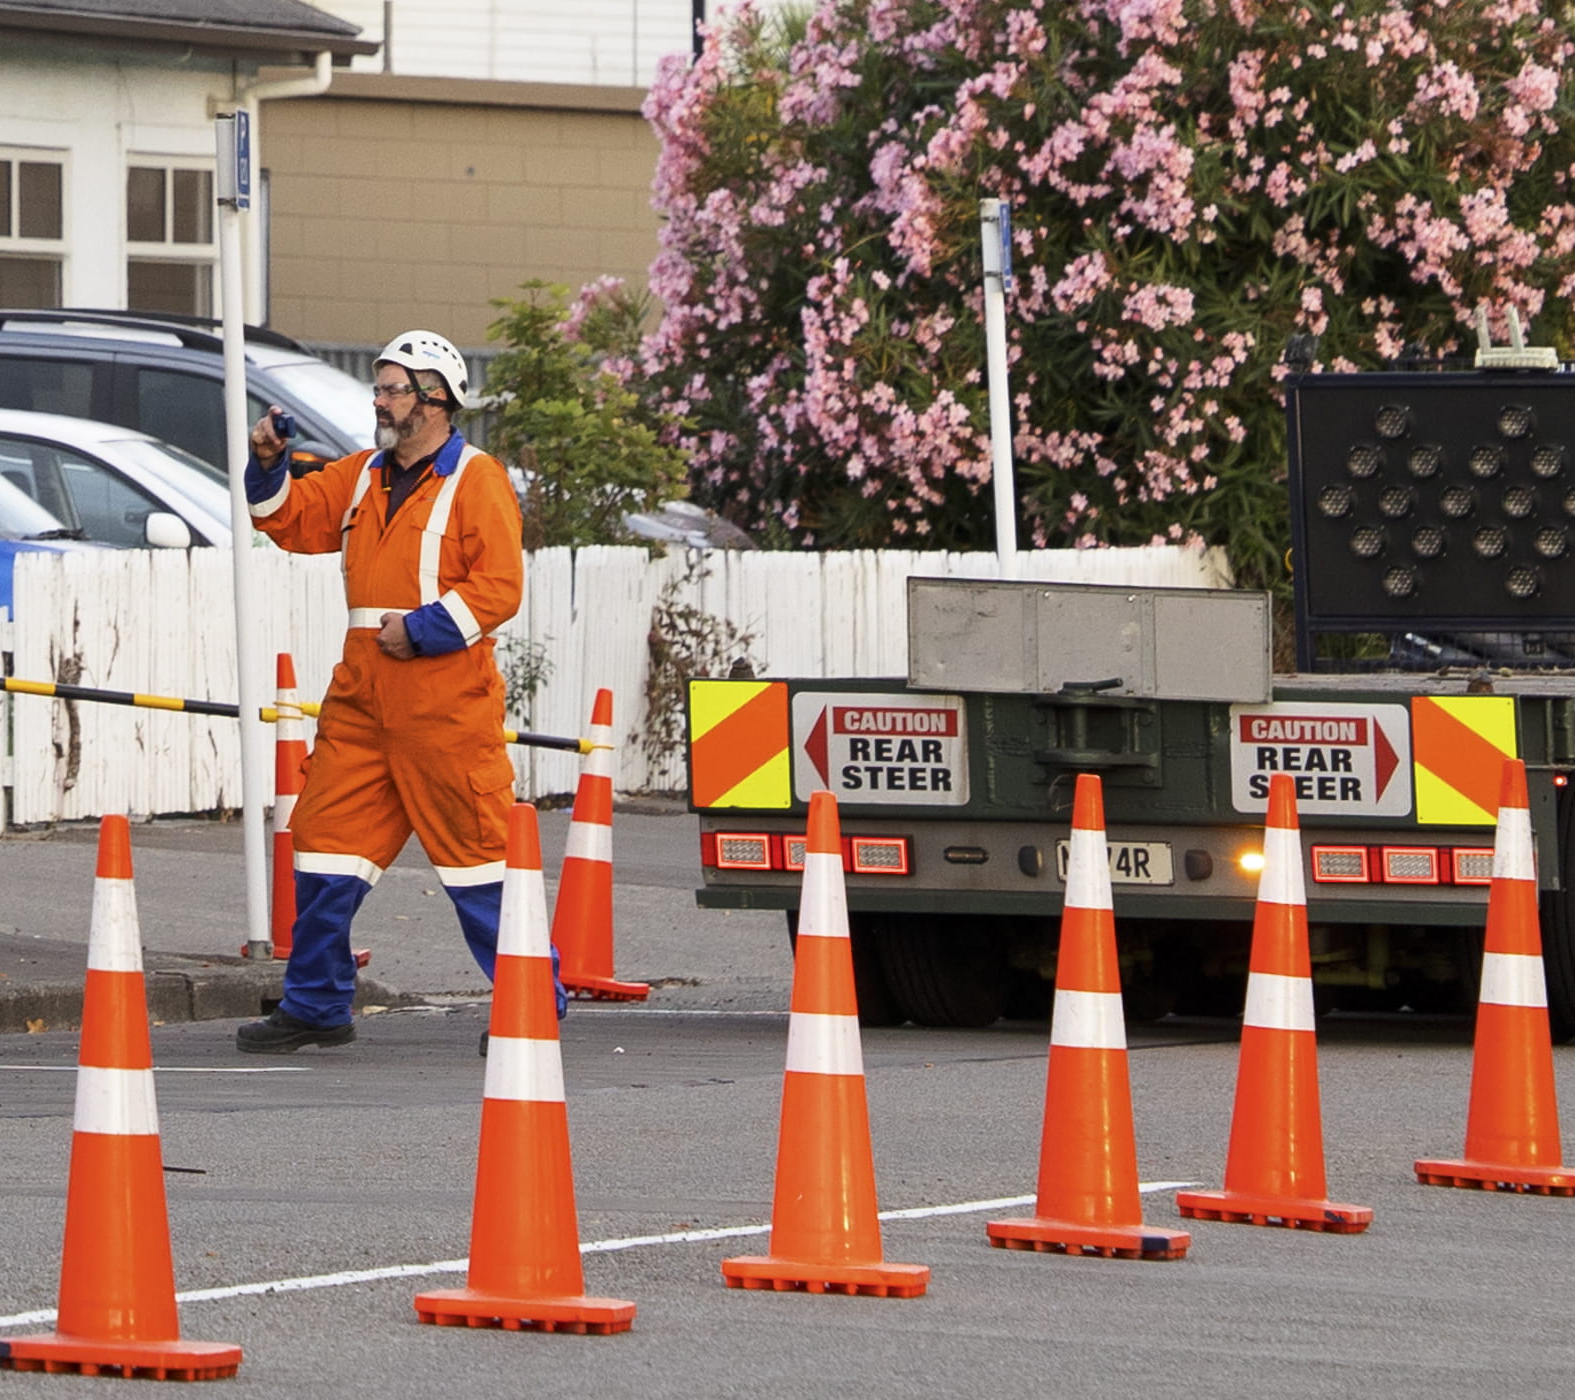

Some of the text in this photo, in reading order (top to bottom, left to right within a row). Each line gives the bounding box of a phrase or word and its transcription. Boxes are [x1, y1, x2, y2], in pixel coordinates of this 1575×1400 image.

[843, 710, 947, 733] CAUTION
[1251, 719, 1357, 741] CAUTION
[849, 737, 943, 763] REAR
[1256, 746, 1353, 773] REAR
[841, 765, 952, 792] STEER
[1249, 774, 1362, 802] SEER
